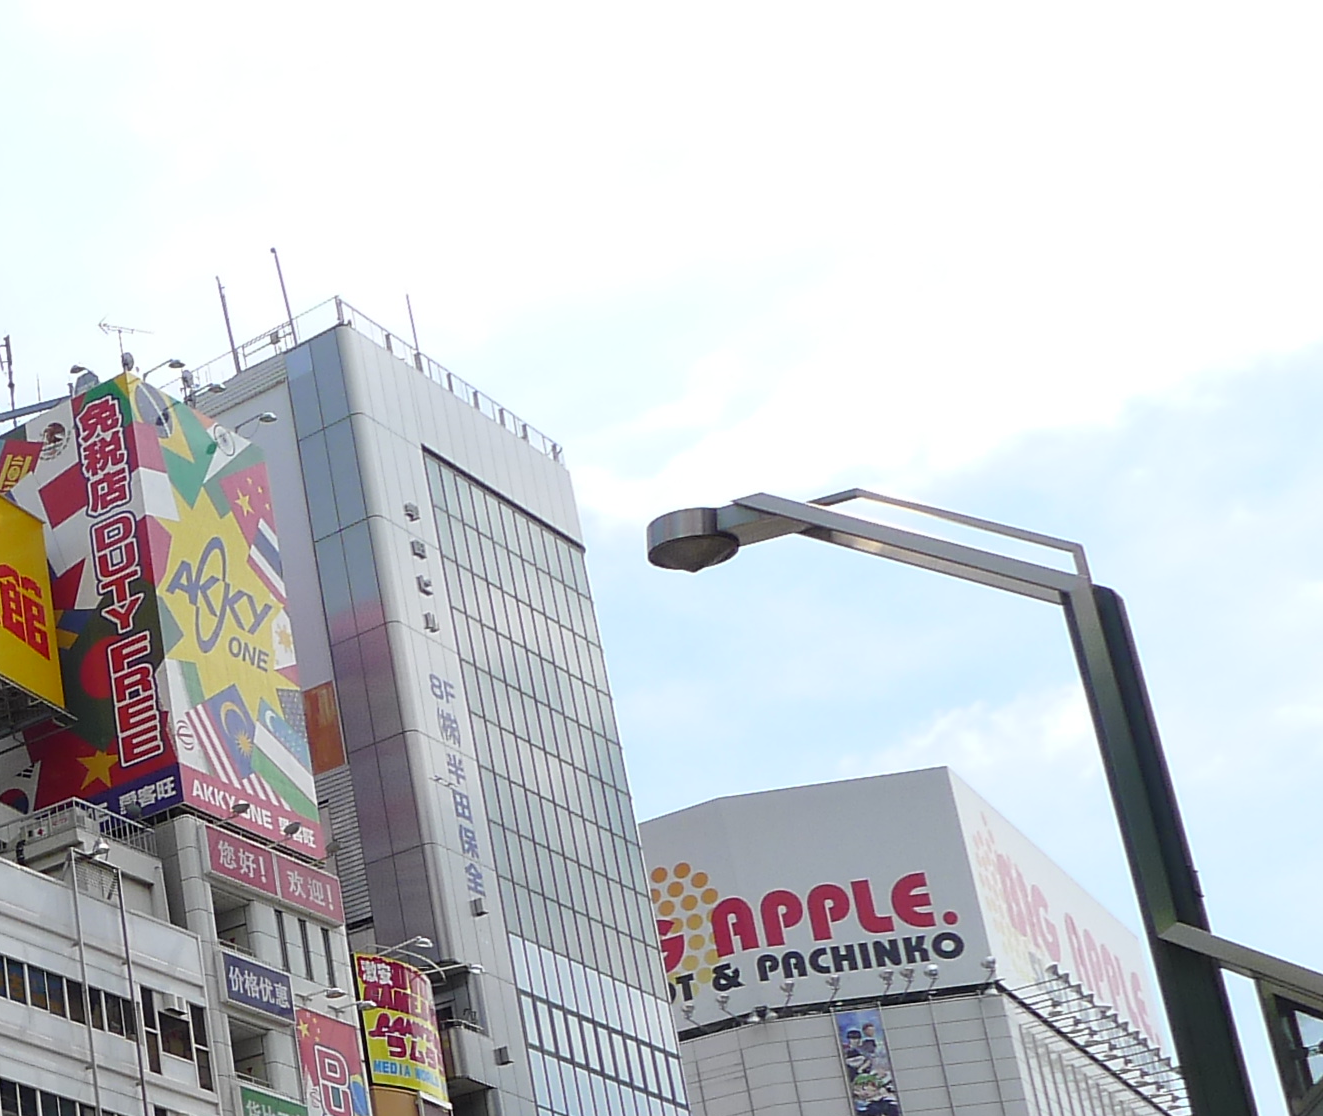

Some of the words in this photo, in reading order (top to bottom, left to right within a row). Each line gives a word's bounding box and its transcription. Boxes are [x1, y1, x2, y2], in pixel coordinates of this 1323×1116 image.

[75, 394, 129, 519] 免税店
[91, 512, 144, 633] DUTY
[227, 637, 271, 674] ONE
[106, 630, 164, 769] FREE
[217, 839, 268, 884] 您好!
[285, 869, 335, 911] 欢迎!
[756, 931, 966, 983] PACHINKO
[228, 965, 291, 1010] 价格优惠
[373, 1059, 412, 1078] MEDIA
